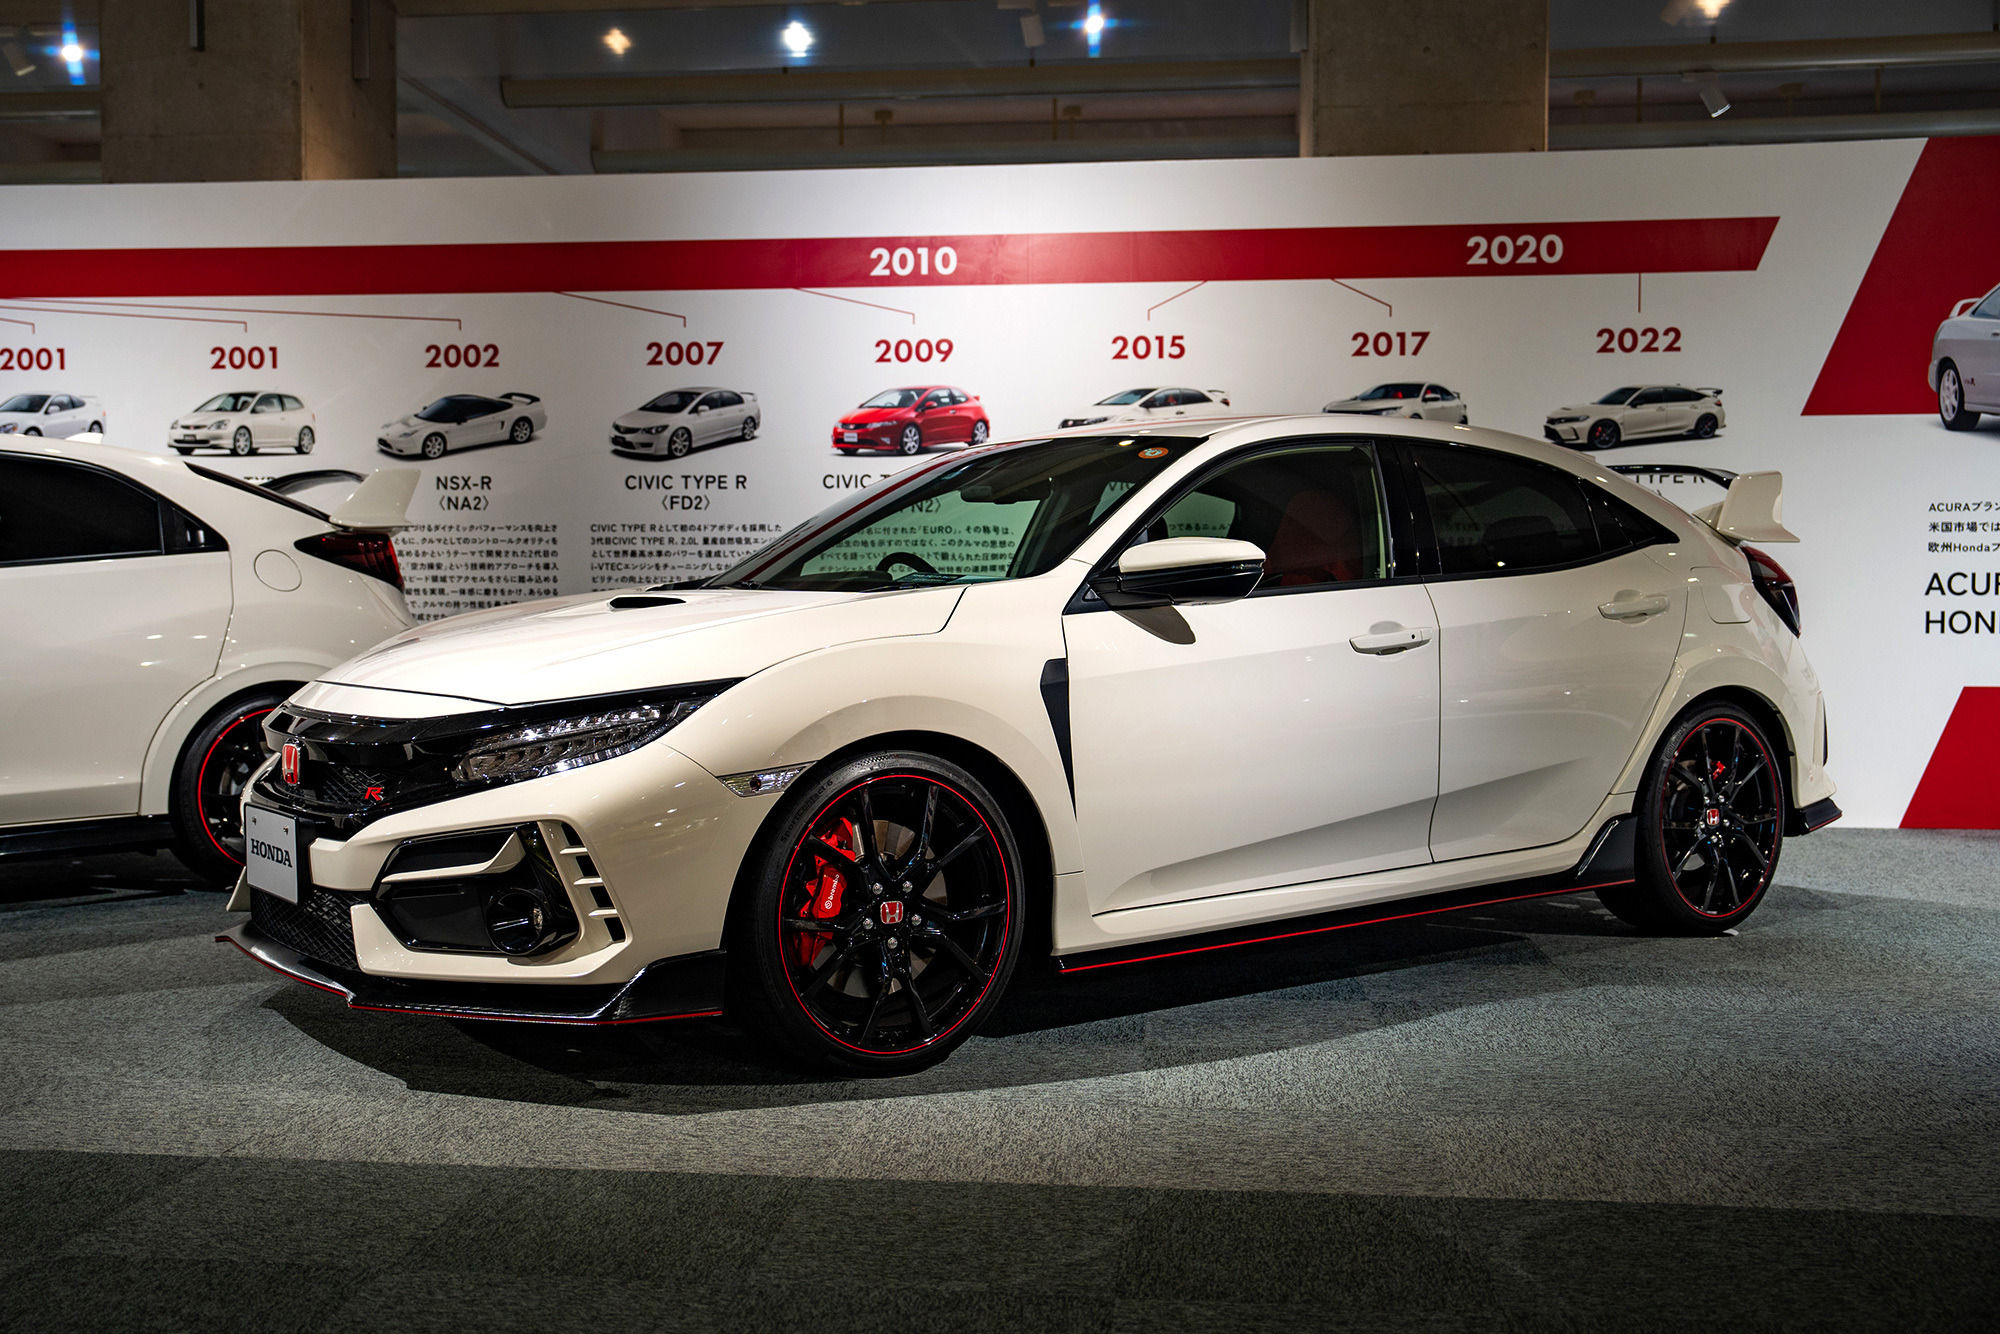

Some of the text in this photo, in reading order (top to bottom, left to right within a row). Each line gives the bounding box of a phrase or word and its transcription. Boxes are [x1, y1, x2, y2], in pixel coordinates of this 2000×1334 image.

[869, 246, 958, 276] 2010
[1466, 234, 1564, 265] 2020
[875, 338, 954, 363] 2009
[1111, 335, 1186, 360] 2015
[1351, 331, 1430, 357] 2017
[1596, 327, 1682, 353] 2022
[0, 348, 65, 371] 2001
[210, 346, 278, 370] 2001
[425, 344, 500, 368] 2002
[646, 341, 724, 365] 2007
[436, 476, 492, 490] NSX-R
[625, 475, 747, 490] CIVIC TYPE R
[823, 474, 871, 490] CIVIC
[590, 523, 617, 532] CIVIC
[621, 523, 646, 532] TYPE
[641, 536, 665, 545] TYPE
[364, 786, 383, 801] R
[251, 838, 292, 868] HONDA
[828, 873, 840, 900] brembo
